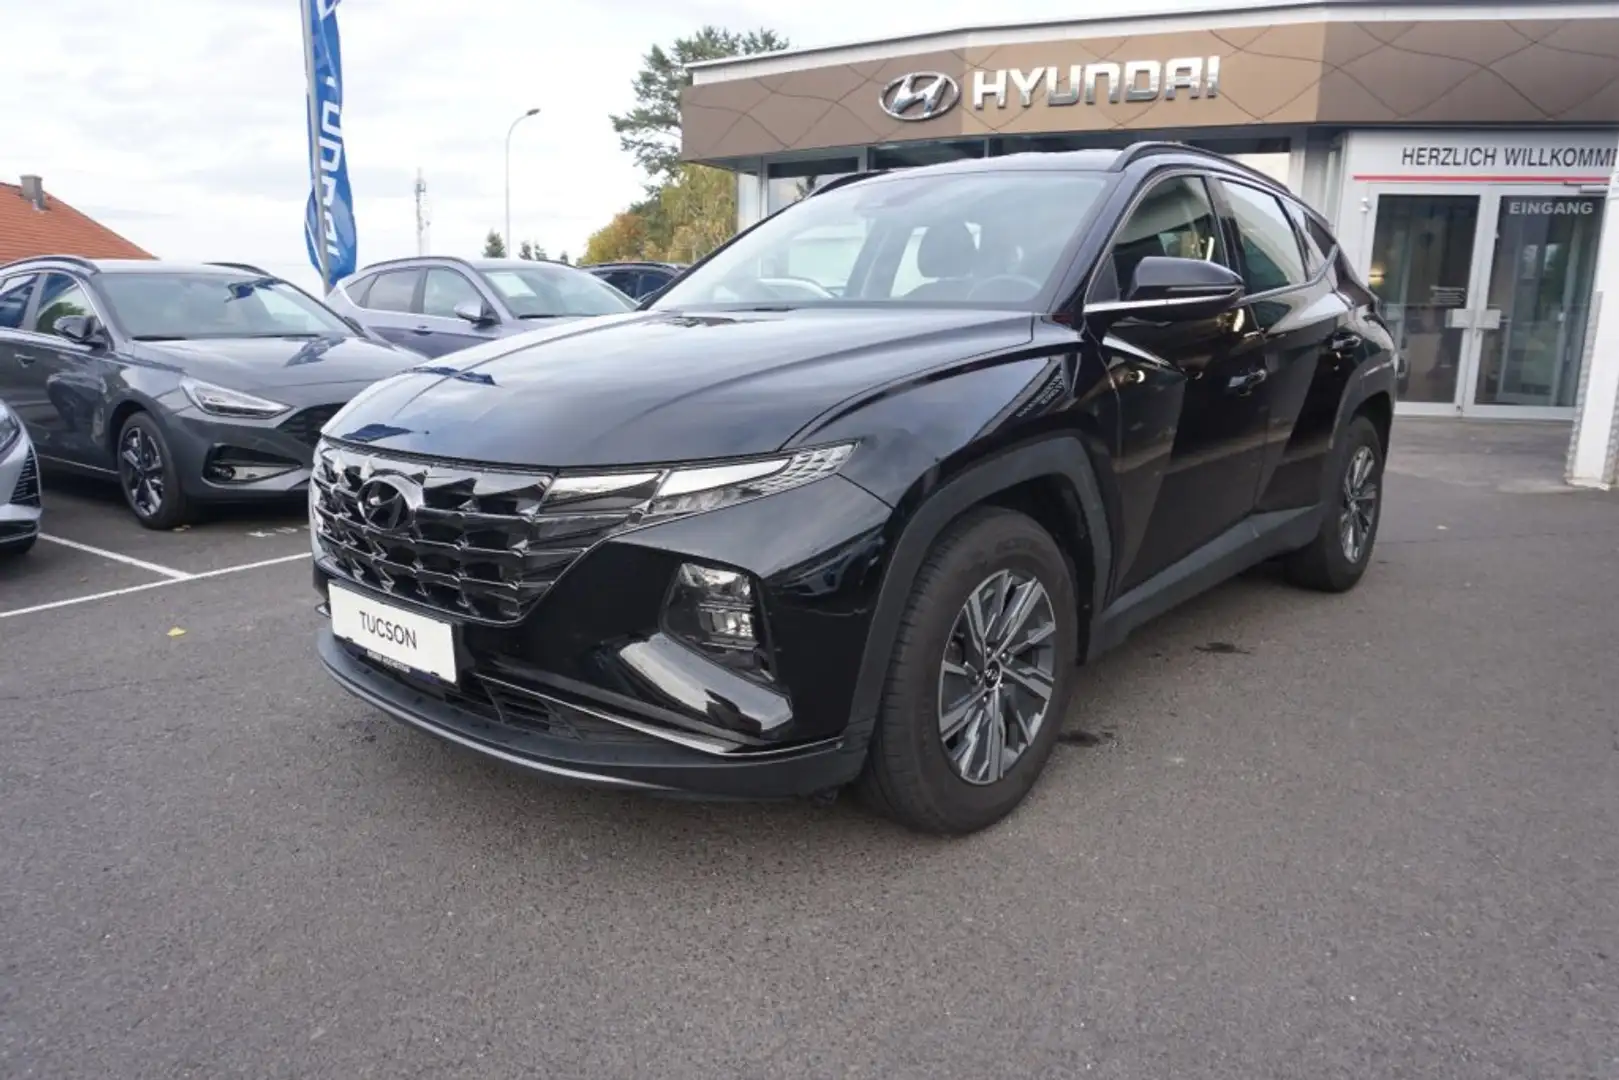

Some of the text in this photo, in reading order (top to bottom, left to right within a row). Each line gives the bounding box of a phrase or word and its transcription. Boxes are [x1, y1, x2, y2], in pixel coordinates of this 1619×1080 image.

[973, 55, 1220, 110] HYUNDAI
[1402, 147, 1497, 166] HERZLICH
[1509, 202, 1593, 215] EINGANG
[359, 611, 417, 650] TUCSON
